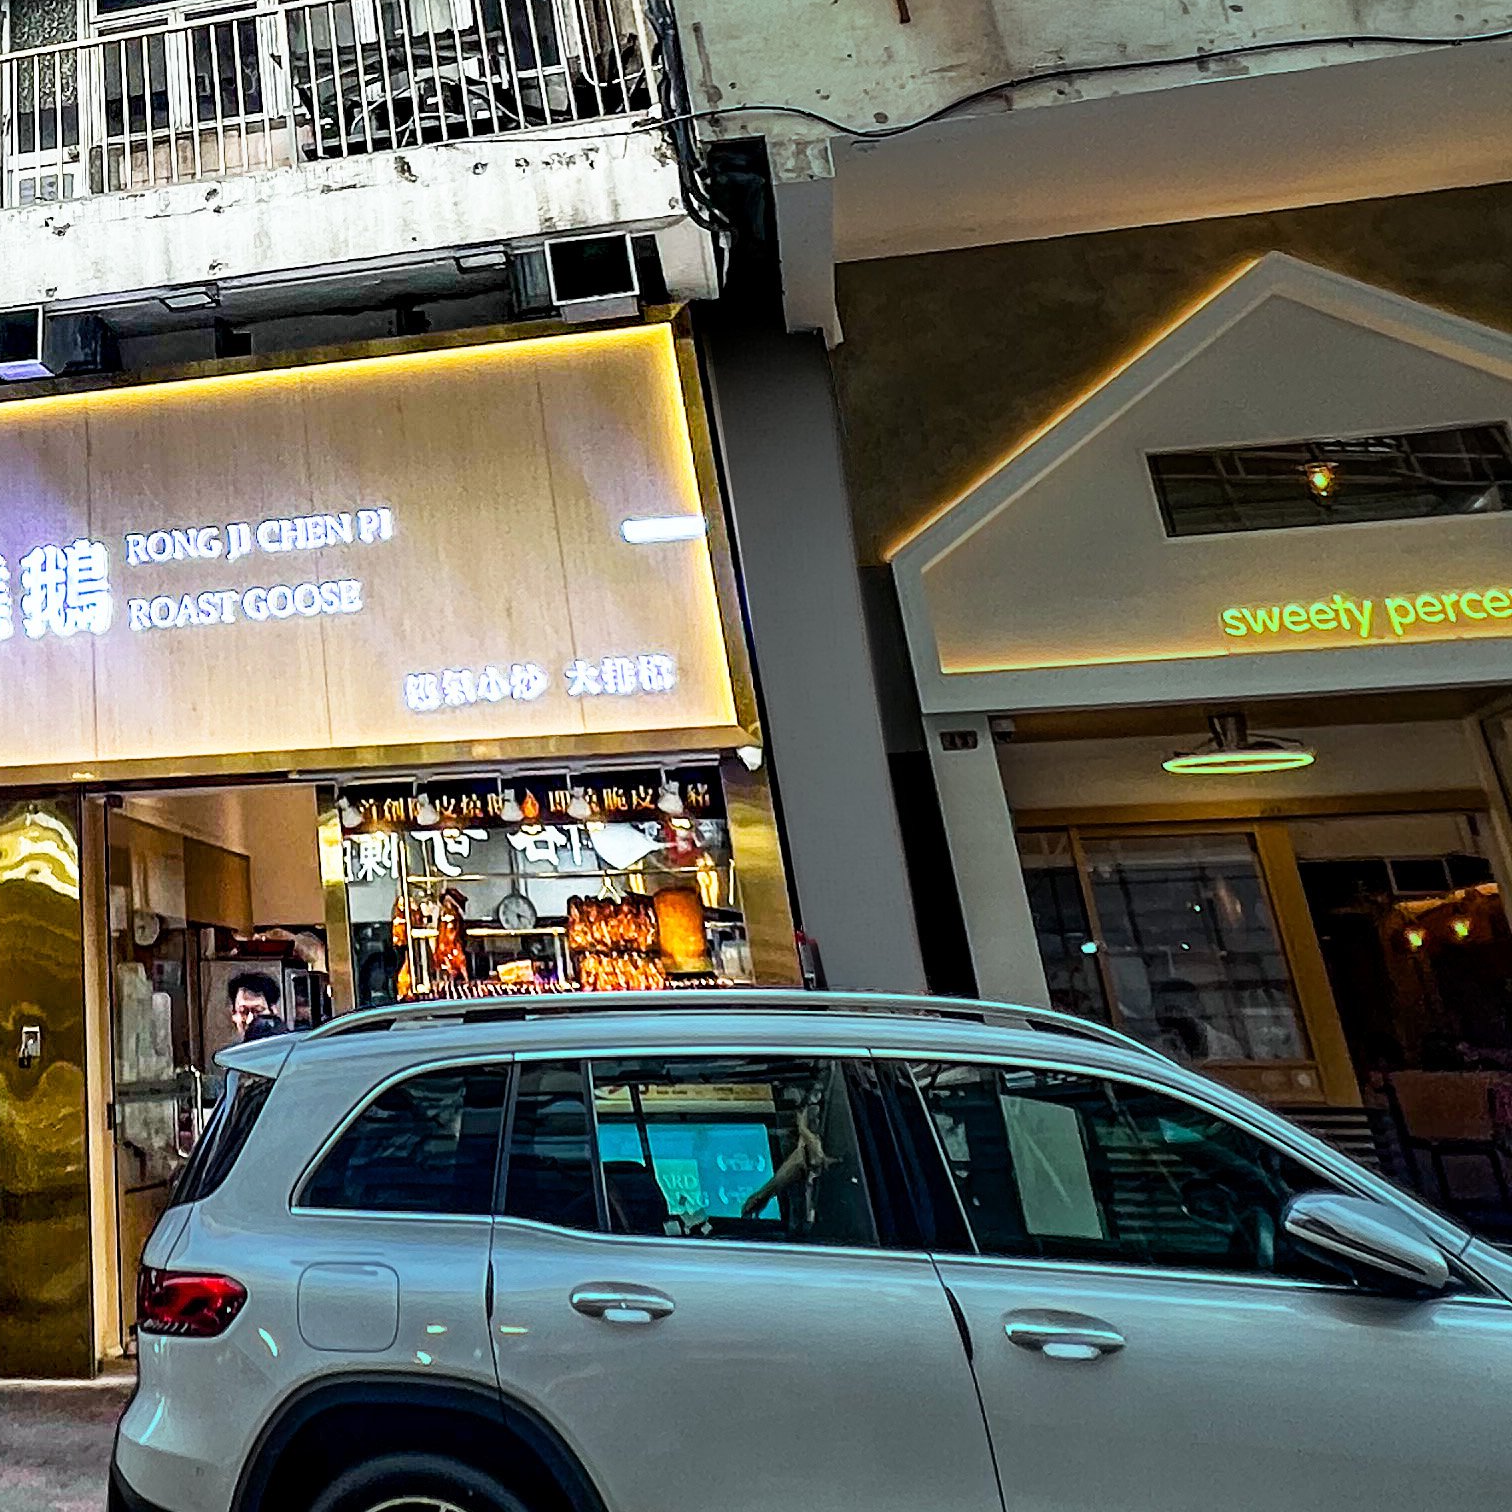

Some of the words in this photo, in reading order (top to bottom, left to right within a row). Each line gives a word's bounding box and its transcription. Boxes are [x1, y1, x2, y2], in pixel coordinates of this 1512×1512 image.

[124, 525, 223, 566] RONG
[225, 522, 252, 560] JI
[255, 512, 354, 553] CHEN
[355, 507, 393, 544] PI
[128, 590, 239, 631] ROAST
[241, 579, 364, 622] GOOSE
[1222, 594, 1374, 638] sweety
[1385, 588, 1512, 636] perce
